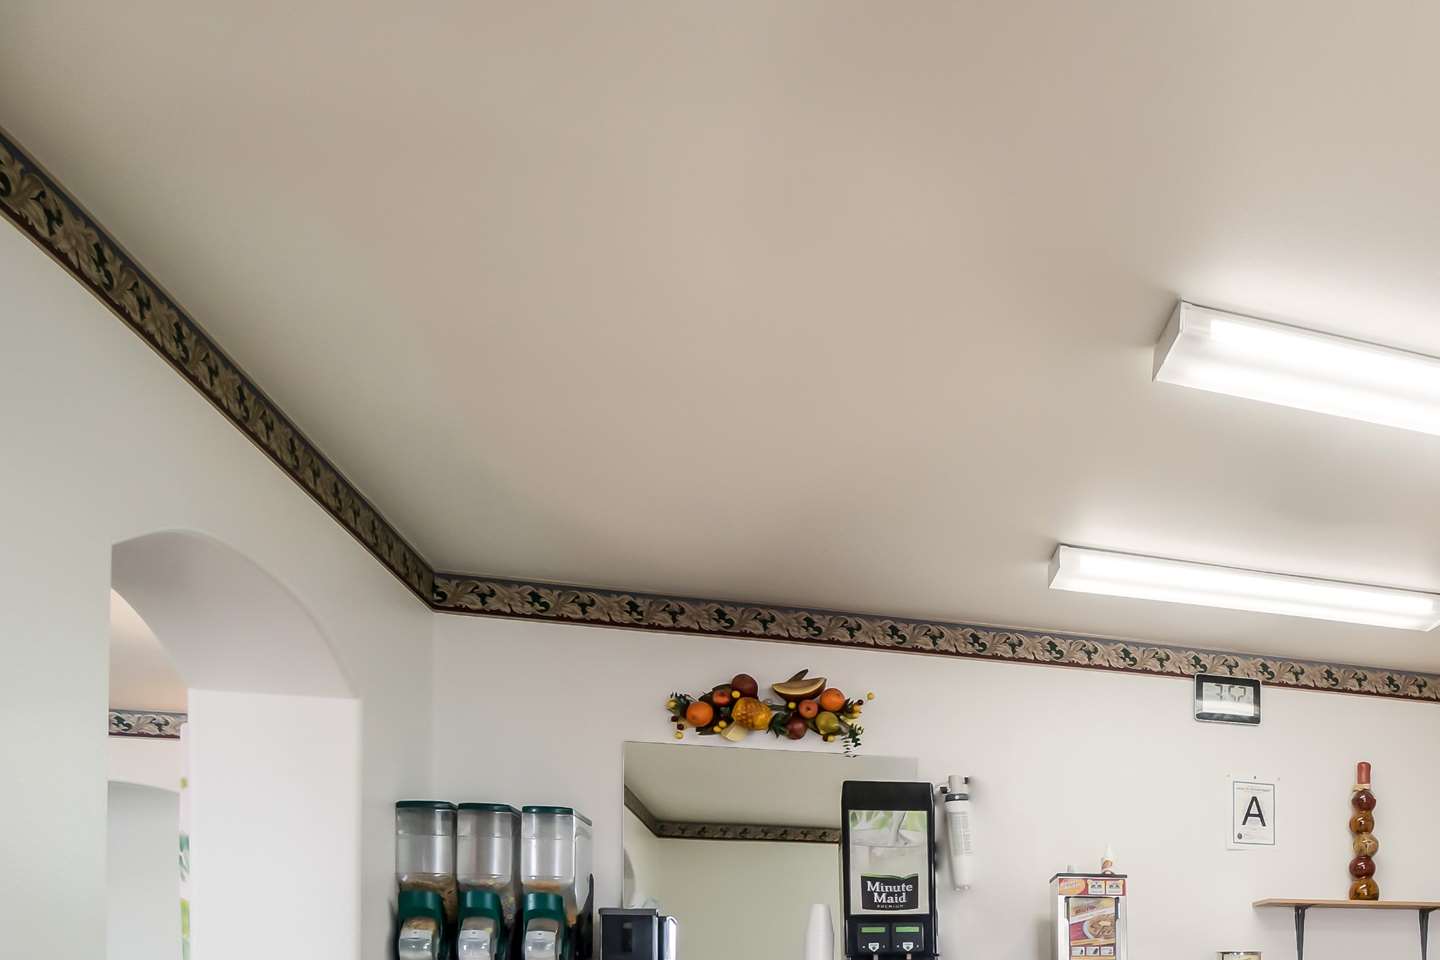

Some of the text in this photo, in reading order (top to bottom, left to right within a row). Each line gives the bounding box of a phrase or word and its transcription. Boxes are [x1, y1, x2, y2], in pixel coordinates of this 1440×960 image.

[1241, 796, 1266, 827] A
[866, 880, 913, 892] Minute
[873, 892, 907, 903] Maid
